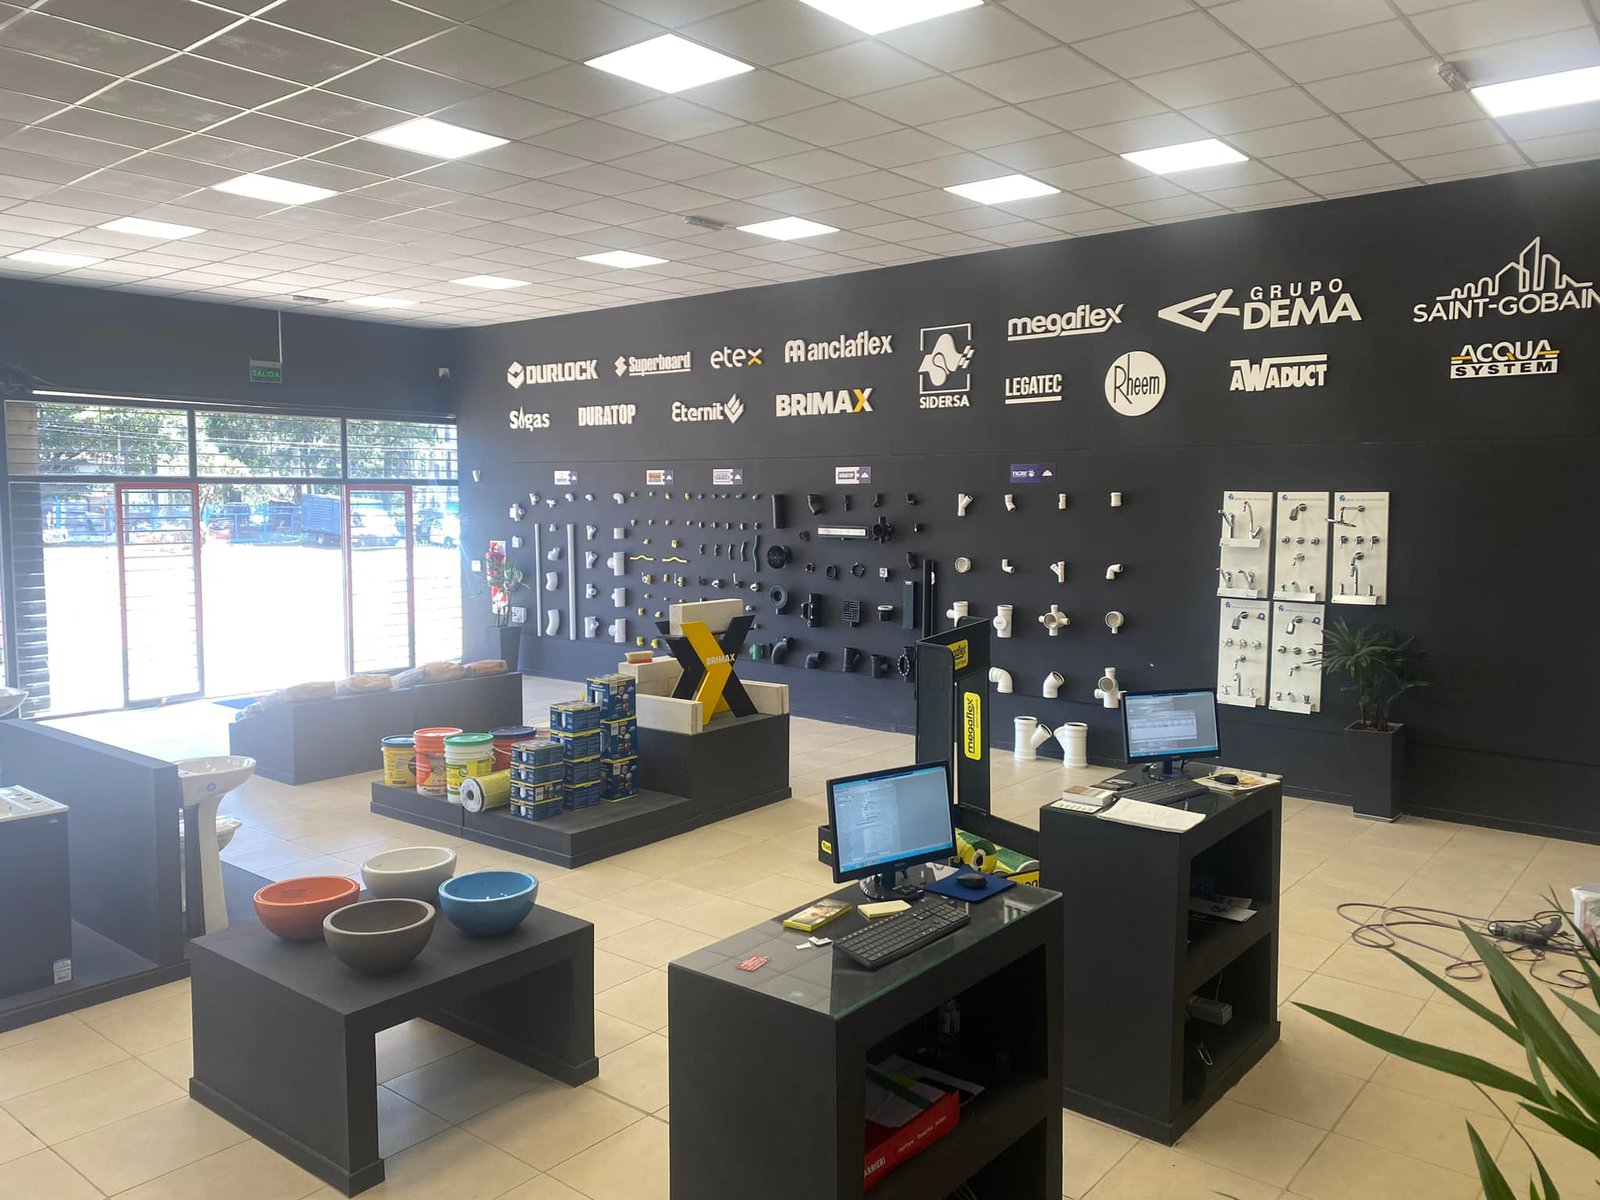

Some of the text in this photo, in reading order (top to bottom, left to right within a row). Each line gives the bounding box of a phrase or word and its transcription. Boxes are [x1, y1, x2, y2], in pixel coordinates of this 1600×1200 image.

[1250, 278, 1343, 300] GRUPO
[1243, 294, 1361, 330] DEMA
[1413, 288, 1600, 323] SAINT-GOBAIN
[1008, 304, 1124, 336] megaflex
[628, 352, 691, 373] Superboard
[711, 347, 762, 368] etex
[1452, 340, 1559, 362] ACQUA
[526, 359, 598, 384] DURLOCK
[1113, 354, 1161, 403] Rheem
[1229, 355, 1328, 393] AWADUCT
[1455, 362, 1552, 376] SYSTEM
[1005, 373, 1063, 397] LEGATEC
[672, 402, 724, 422] Eternit
[776, 388, 873, 416] BRIMAX
[919, 394, 970, 409] SIDERSA
[509, 407, 550, 432] Sigas
[578, 404, 636, 427] DURATOP
[706, 653, 735, 665] BRIMAX
[966, 698, 974, 754] megaflex
